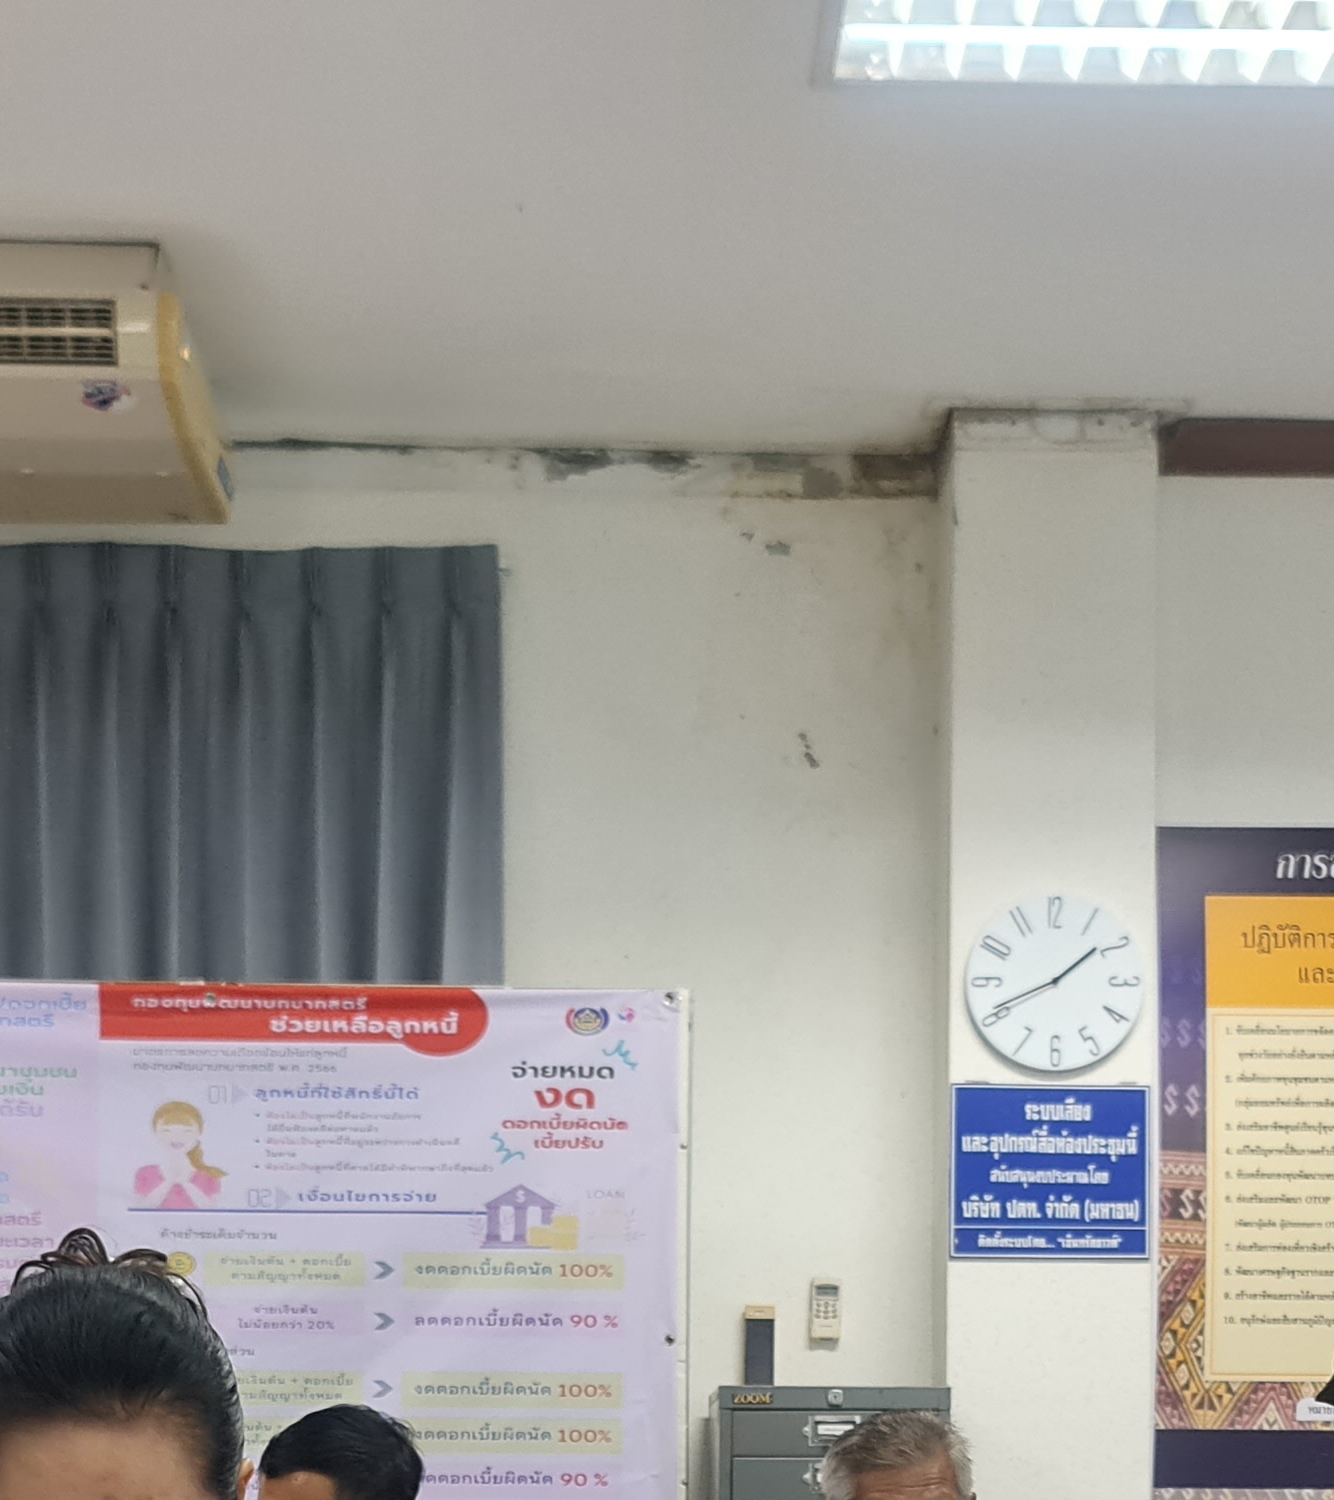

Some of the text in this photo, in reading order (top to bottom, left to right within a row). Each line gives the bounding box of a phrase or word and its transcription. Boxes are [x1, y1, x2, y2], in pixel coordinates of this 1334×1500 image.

[1009, 905, 1033, 938] 11
[1047, 896, 1063, 930] 12
[1081, 906, 1100, 937] 1
[979, 934, 1012, 961] 10
[1100, 935, 1131, 959] 2
[970, 975, 1004, 989] 9
[1108, 974, 1141, 989] 3
[981, 1005, 1012, 1028] 8
[1102, 1004, 1130, 1024] 4
[269, 1011, 459, 1040] ช่วยเหลือลูกหนี้
[1012, 1026, 1034, 1058] 7
[1049, 1034, 1062, 1068] 6
[1078, 1025, 1101, 1057] 5
[510, 1062, 616, 1083] จ่ายหมด
[533, 1085, 597, 1112] งด
[1023, 1097, 1092, 1122] ระบบเสียง
[501, 1115, 630, 1133] ดอกเบี้ยผิดนัด
[533, 1133, 605, 1152] เบี้ยปรับ
[297, 1186, 438, 1205] เงื่อนไขการจ่าย
[1305, 1196, 1331, 1205] OTOP
[961, 1195, 1001, 1219] บริษัท
[1045, 1195, 1081, 1219] จำกัด
[414, 1259, 614, 1279] งดดอกเบี้ยผิดนัด 100%
[413, 1310, 620, 1330] ลดดอกเบี้ยผิดนัด 90 %
[413, 1378, 614, 1399] งดดอกเบี้ยผิดนัด 100%
[557, 1428, 614, 1445] 100%
[560, 1471, 590, 1488] 90
[593, 1471, 610, 1488] %
